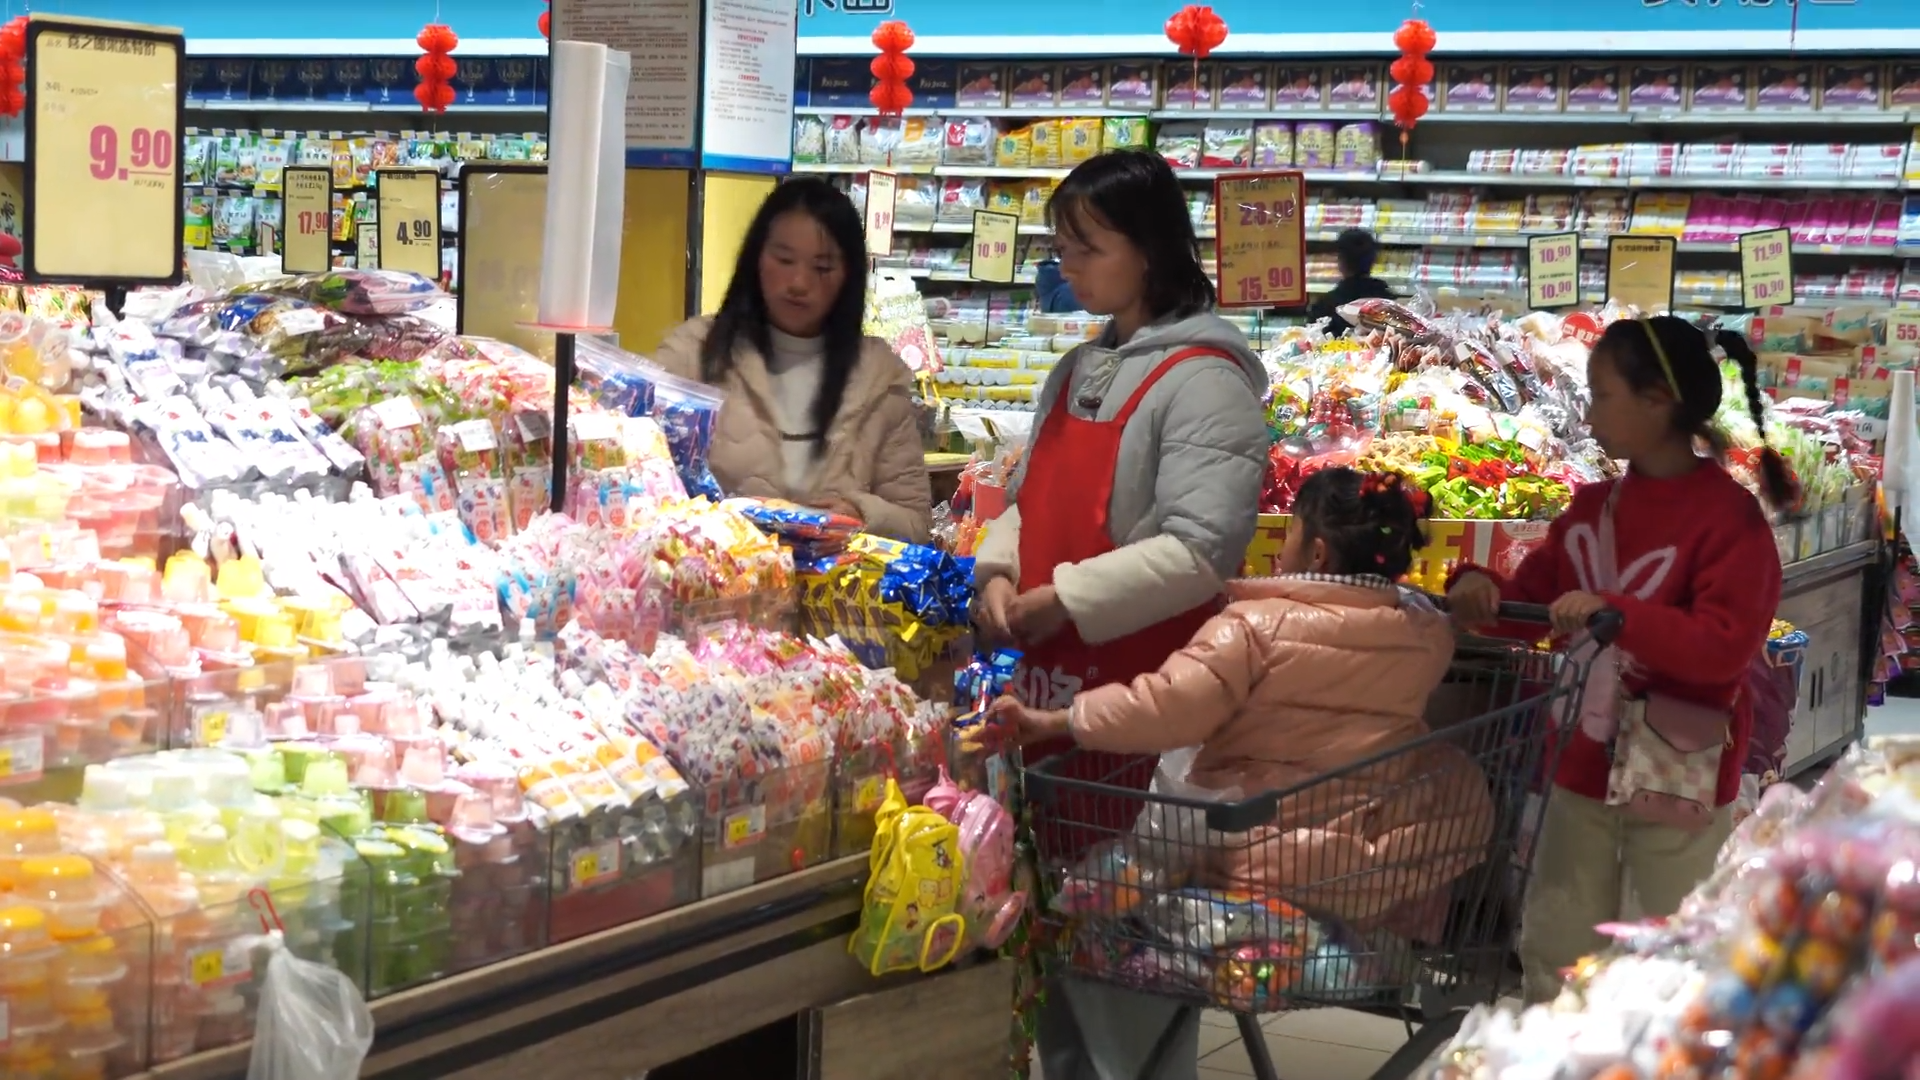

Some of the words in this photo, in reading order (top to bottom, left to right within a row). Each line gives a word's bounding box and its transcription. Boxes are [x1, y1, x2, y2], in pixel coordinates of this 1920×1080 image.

[90, 125, 172, 181] 9.90
[298, 211, 328, 235] 17.90
[396, 219, 432, 245] 4.90
[977, 241, 1008, 259] 10.90
[1539, 244, 1572, 264] 10.90
[1237, 266, 1294, 301] 15.90
[1540, 280, 1572, 300] 10.90
